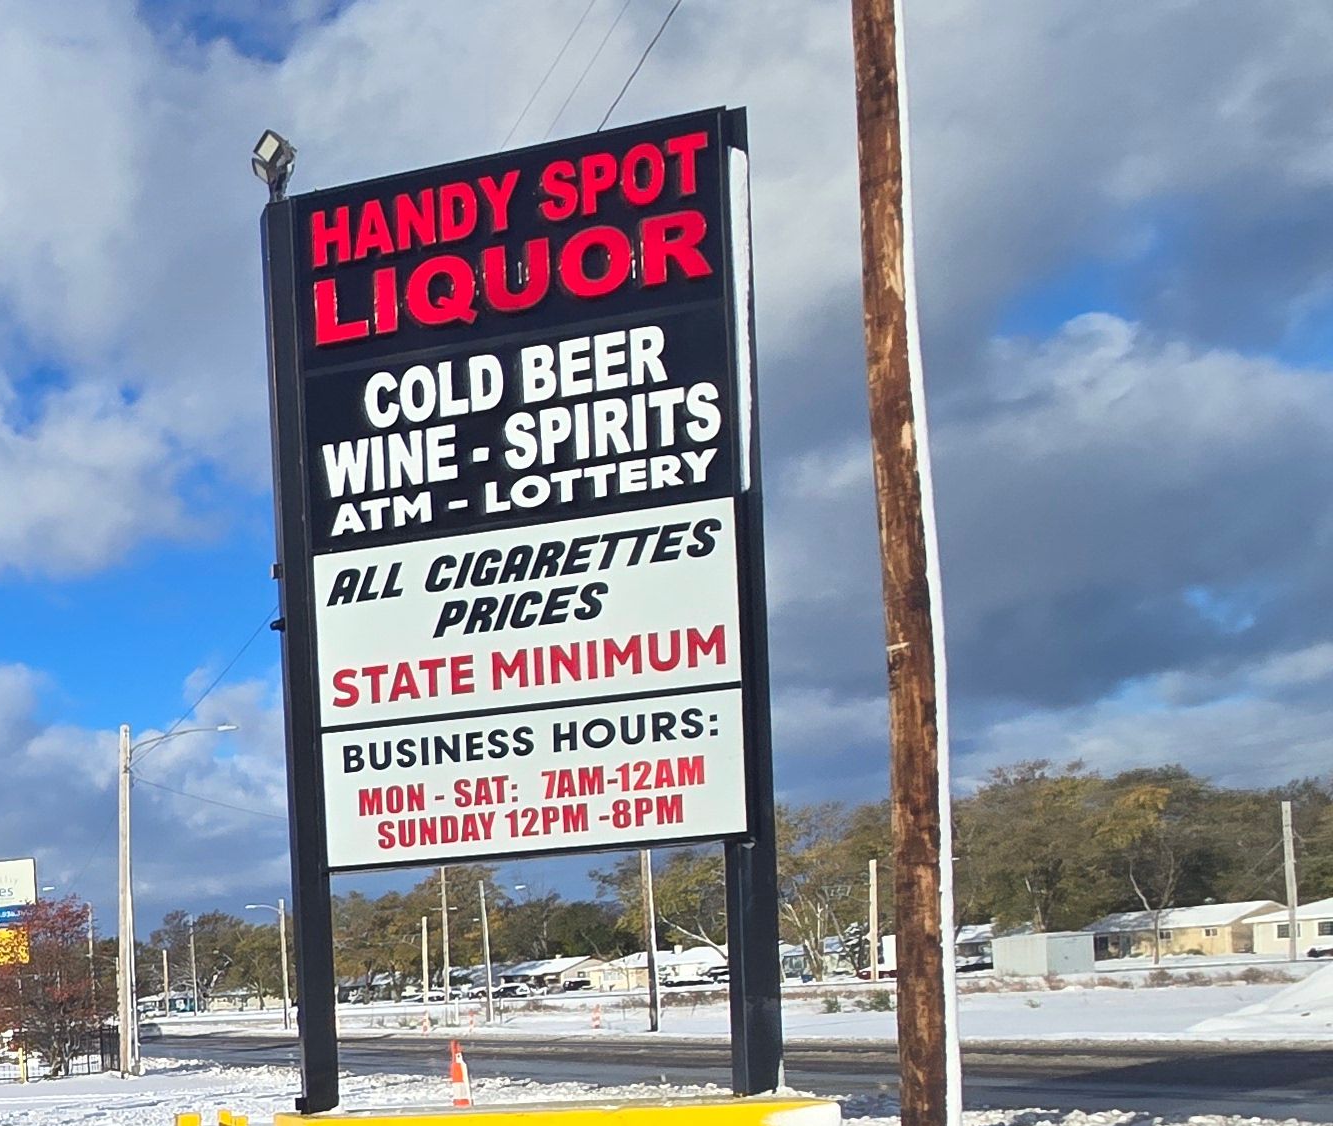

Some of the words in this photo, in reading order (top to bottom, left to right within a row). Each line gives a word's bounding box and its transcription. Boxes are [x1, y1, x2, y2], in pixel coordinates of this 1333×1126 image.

[312, 170, 520, 268] HANDY
[540, 131, 709, 222] SPOT
[314, 210, 714, 346] LIQUOR
[364, 354, 505, 428] COLD
[521, 326, 669, 402] BEER
[322, 424, 458, 498] WINE
[504, 382, 722, 471] SPIRITS
[330, 498, 433, 537] ATM
[486, 448, 718, 514] LOTTERY
[327, 562, 403, 607] ALL
[425, 518, 723, 593] CIGARETTES
[433, 582, 610, 638] PRICES
[332, 654, 476, 708] STATE
[492, 624, 728, 691] MINIMUM
[343, 725, 535, 774] BUSINESS
[553, 707, 720, 752] HOURS:
[358, 783, 426, 817] MON
[454, 774, 519, 807] SAT:
[541, 755, 706, 800] 7AM-12AM
[377, 810, 495, 850] SUNDAY
[505, 802, 589, 838] 12PM
